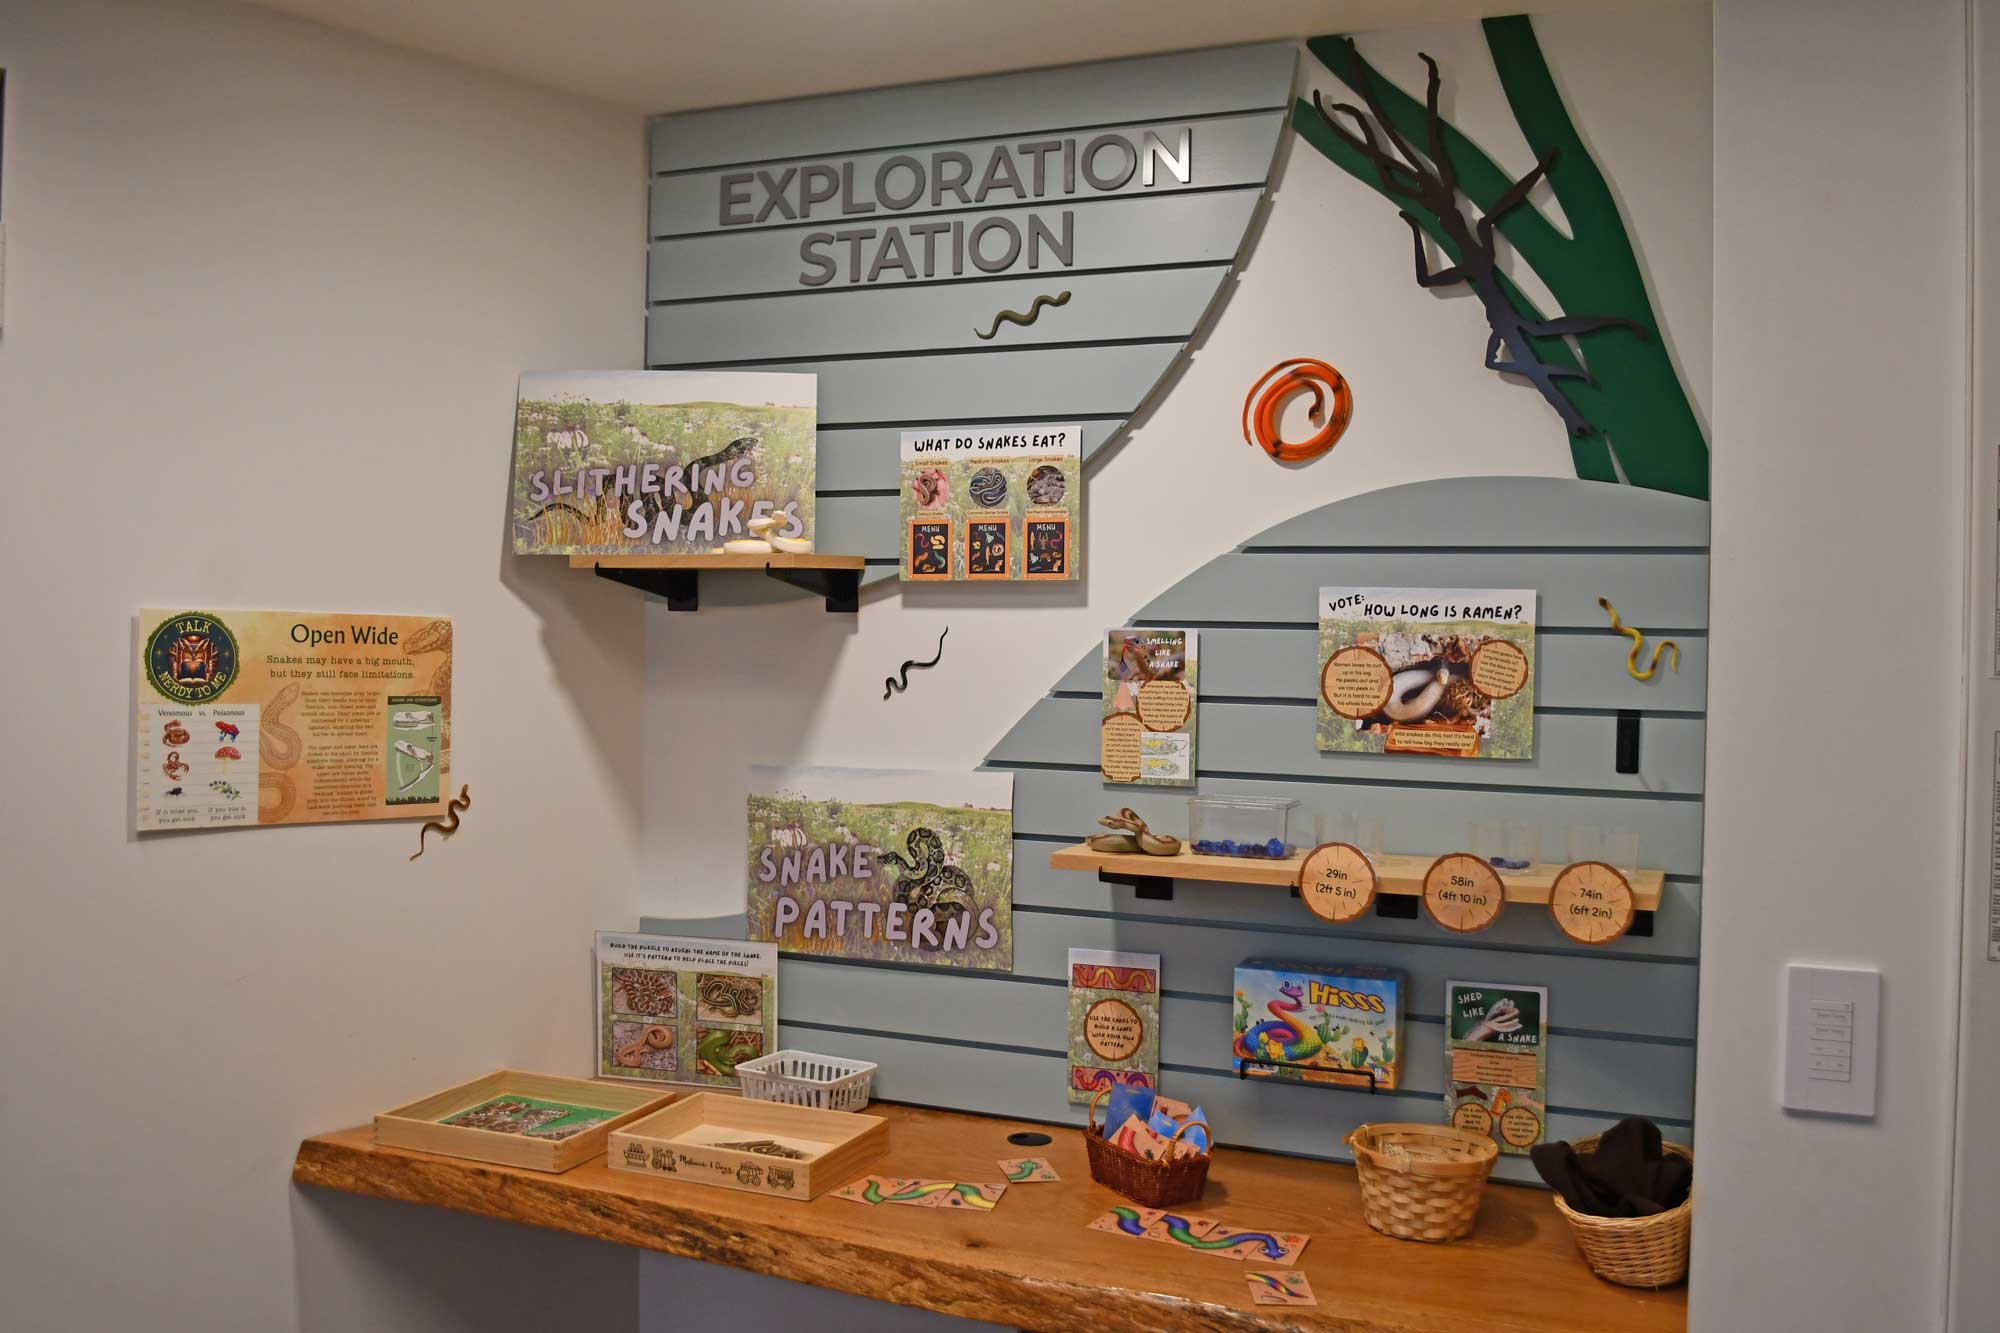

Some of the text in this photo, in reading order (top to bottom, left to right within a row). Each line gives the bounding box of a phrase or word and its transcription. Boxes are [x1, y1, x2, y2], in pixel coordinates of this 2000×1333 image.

[719, 127, 1192, 226] EXPLORATION
[799, 210, 1074, 286] STATION
[914, 432, 1066, 452] WHAT DO SNAKES EAT?
[529, 458, 754, 502] SLITHERING
[623, 497, 803, 545] SNAKES
[1036, 523, 1056, 531] MENU
[921, 525, 940, 533] MENU
[978, 524, 997, 532] MENU
[1328, 594, 1365, 612] VOTE:
[1364, 603, 1523, 620] HOW LONG IS RAMEN?
[176, 620, 212, 634] TALK
[291, 624, 399, 647] Open Wide
[1146, 637, 1183, 646] SMELLING
[266, 655, 416, 667] Snakes may have a big mouth,
[1156, 661, 1179, 669] SNAKE
[270, 669, 287, 678] but
[290, 669, 313, 680] they
[316, 669, 336, 679] still
[339, 669, 361, 679] face
[159, 671, 227, 699] NERDY TO ME
[213, 709, 245, 717] Poisonous
[758, 842, 872, 887] SNAKE
[1326, 868, 1348, 880] 29in
[1451, 875, 1474, 888] 58in
[1315, 882, 1357, 899] (2ft 5 in)
[1579, 887, 1602, 900] 74in
[1438, 889, 1487, 906] (4ft 10 in)
[1569, 904, 1613, 920] (6ft 2in)
[774, 896, 999, 952] PATTERNS
[647, 953, 672, 961] PATTERN
[697, 957, 715, 965] PLACE
[1457, 991, 1482, 1004] SHED
[1463, 1007, 1485, 1018] LIKE
[1100, 1040, 1124, 1048] PATTERN
[1498, 1033, 1537, 1044] A SNAKE
